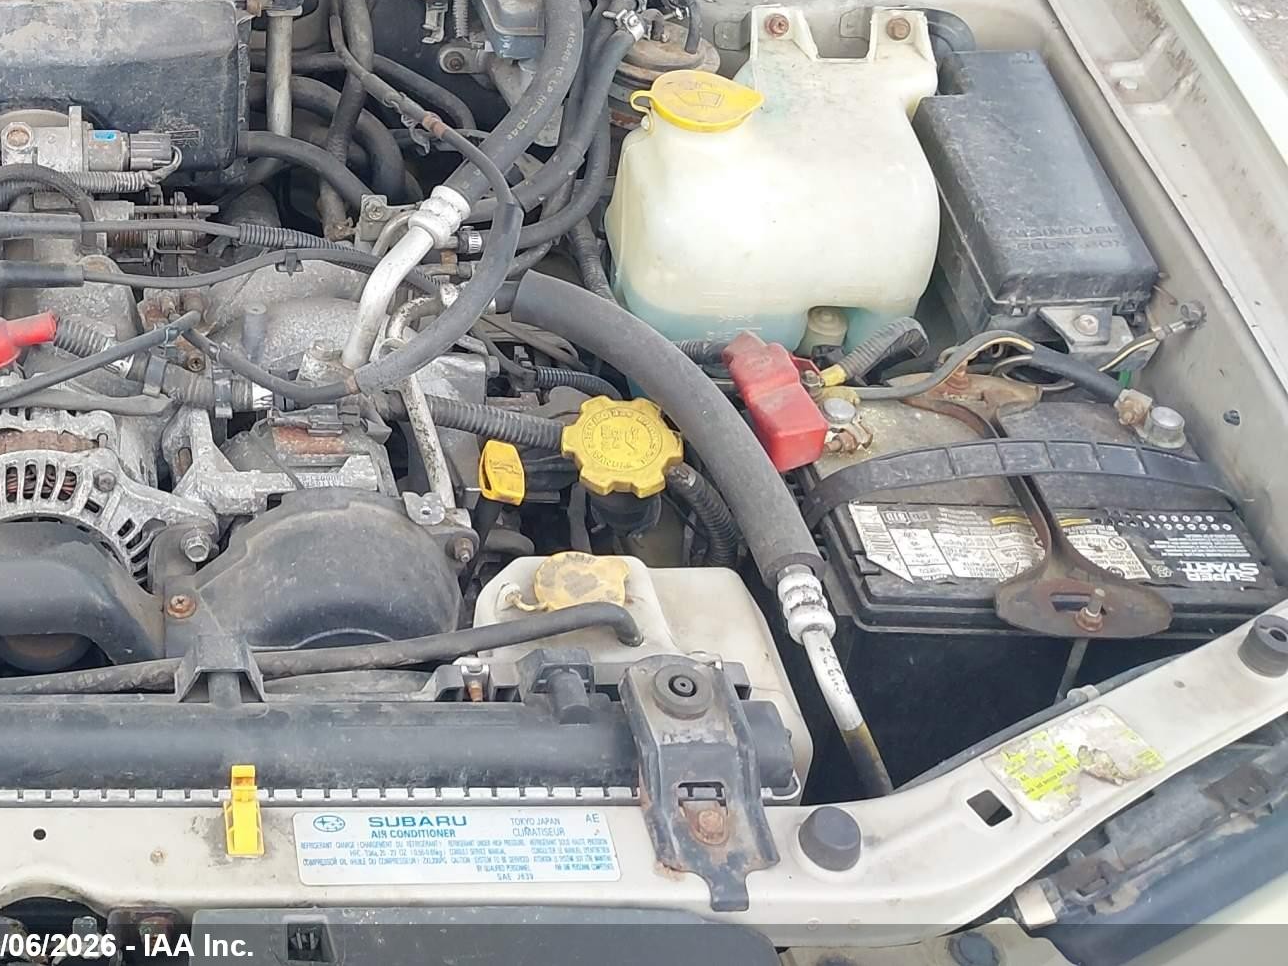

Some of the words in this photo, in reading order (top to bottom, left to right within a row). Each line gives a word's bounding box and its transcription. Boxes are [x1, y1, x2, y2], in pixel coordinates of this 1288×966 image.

[1182, 561, 1260, 575] START
[1185, 571, 1257, 582] SUPER
[368, 816, 467, 828] SUBARU
[510, 817, 536, 825] TOKYO
[537, 817, 561, 825] JAPAN
[585, 813, 600, 823] AE
[371, 830, 388, 838] AIR
[390, 829, 456, 838] CONDITIONER
[512, 827, 566, 837] CLIMATISEUR
[496, 872, 513, 881] SAE
